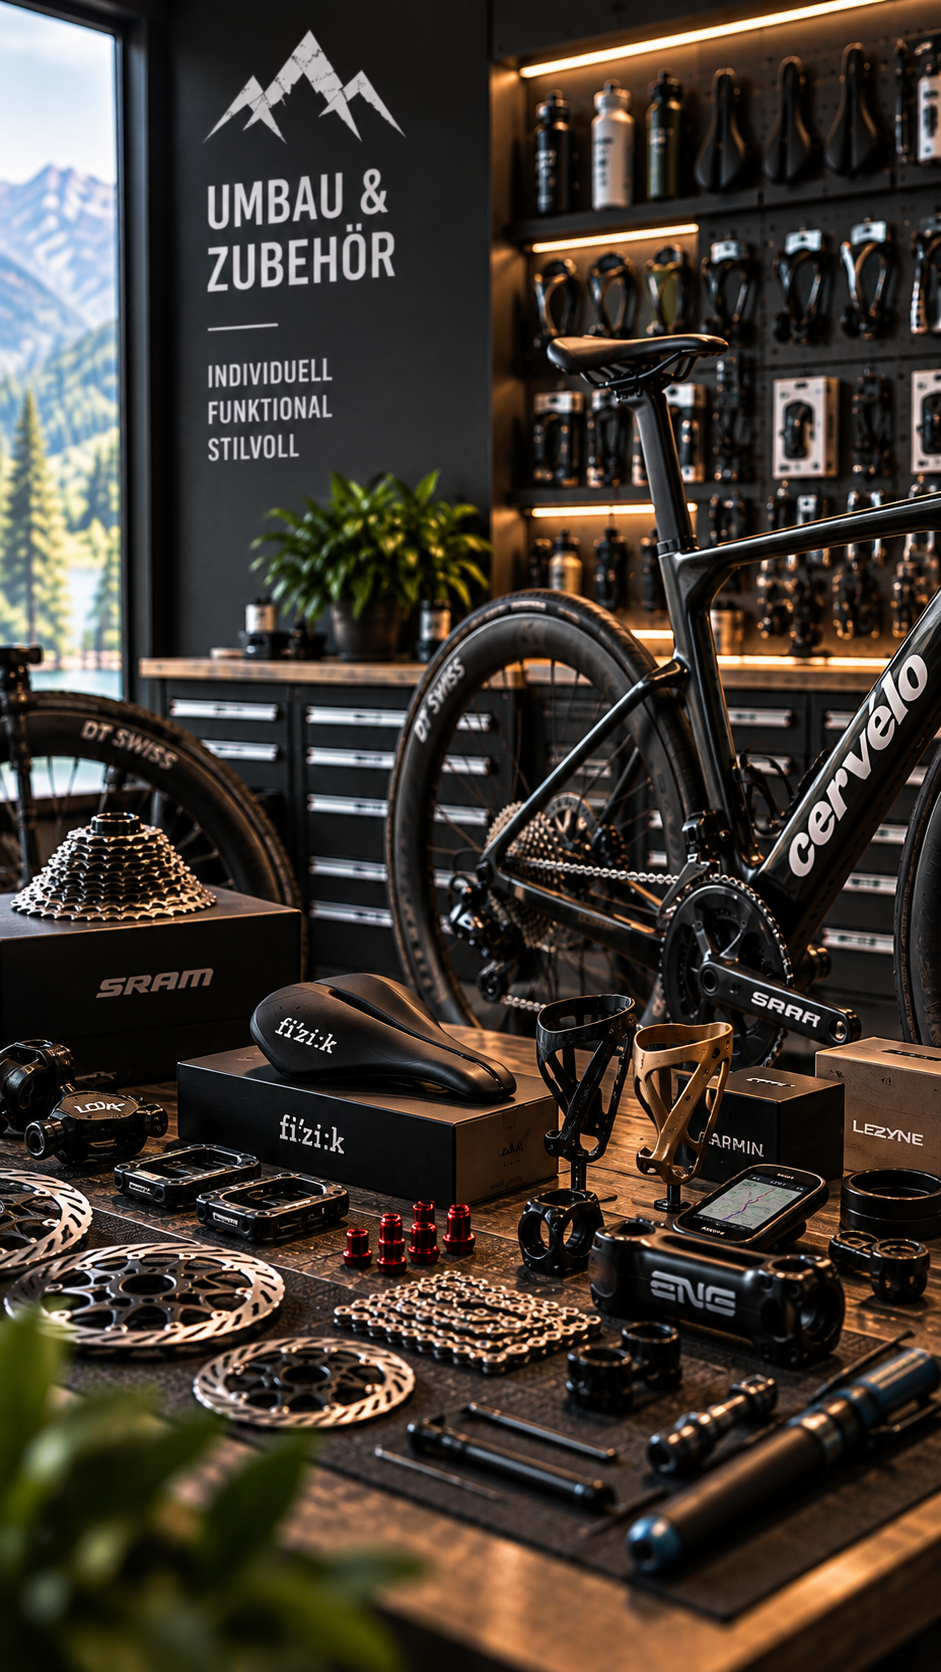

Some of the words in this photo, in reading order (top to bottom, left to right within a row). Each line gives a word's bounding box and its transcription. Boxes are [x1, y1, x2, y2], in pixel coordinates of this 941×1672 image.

[207, 171, 344, 230] UMBAU
[359, 168, 389, 215] &
[207, 223, 396, 293] ZUBEHÖR
[207, 357, 334, 389] INDIVIDUELL
[207, 394, 334, 425] FUNKTIONAL
[207, 433, 300, 462] STILVOLL
[414, 703, 432, 743] DT
[81, 720, 114, 742] DT
[111, 727, 179, 770] SWISS
[788, 654, 929, 878] cervélo
[95, 967, 214, 999] SRAM
[852, 1119, 924, 1147] LEZYNE
